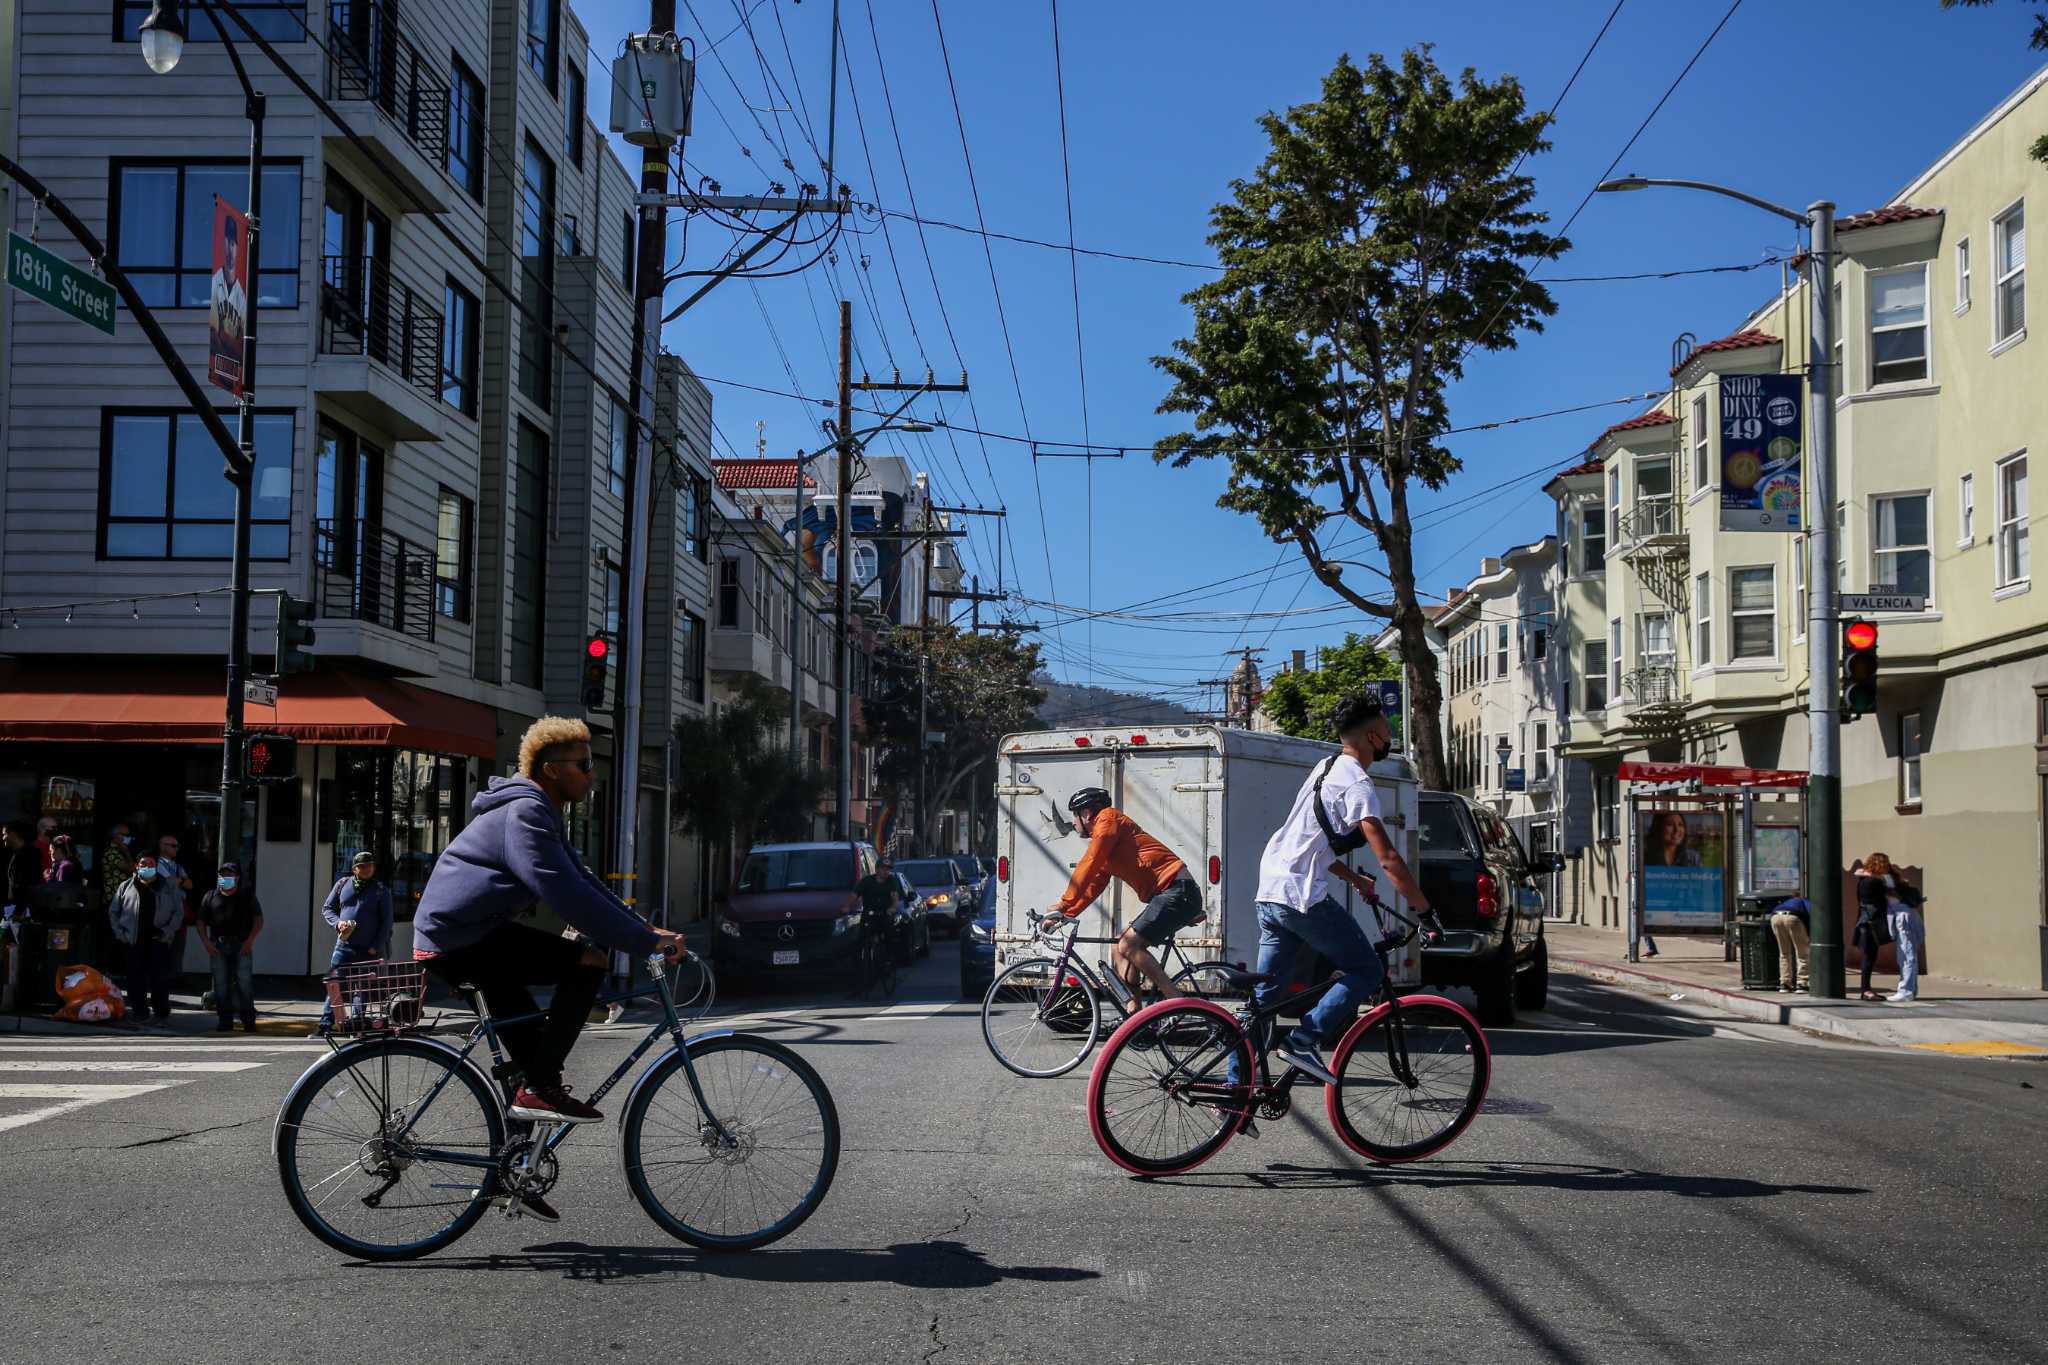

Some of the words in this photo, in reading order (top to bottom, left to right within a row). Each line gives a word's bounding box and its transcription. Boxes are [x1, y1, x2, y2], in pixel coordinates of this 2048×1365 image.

[15, 249, 52, 292] 18th
[60, 274, 110, 321] Street
[1723, 377, 1761, 396] SHOP
[1724, 397, 1761, 417] DINE
[1724, 418, 1763, 439] 49
[1852, 597, 1913, 608] VALENCIA
[592, 1075, 617, 1101] PUBLIC
